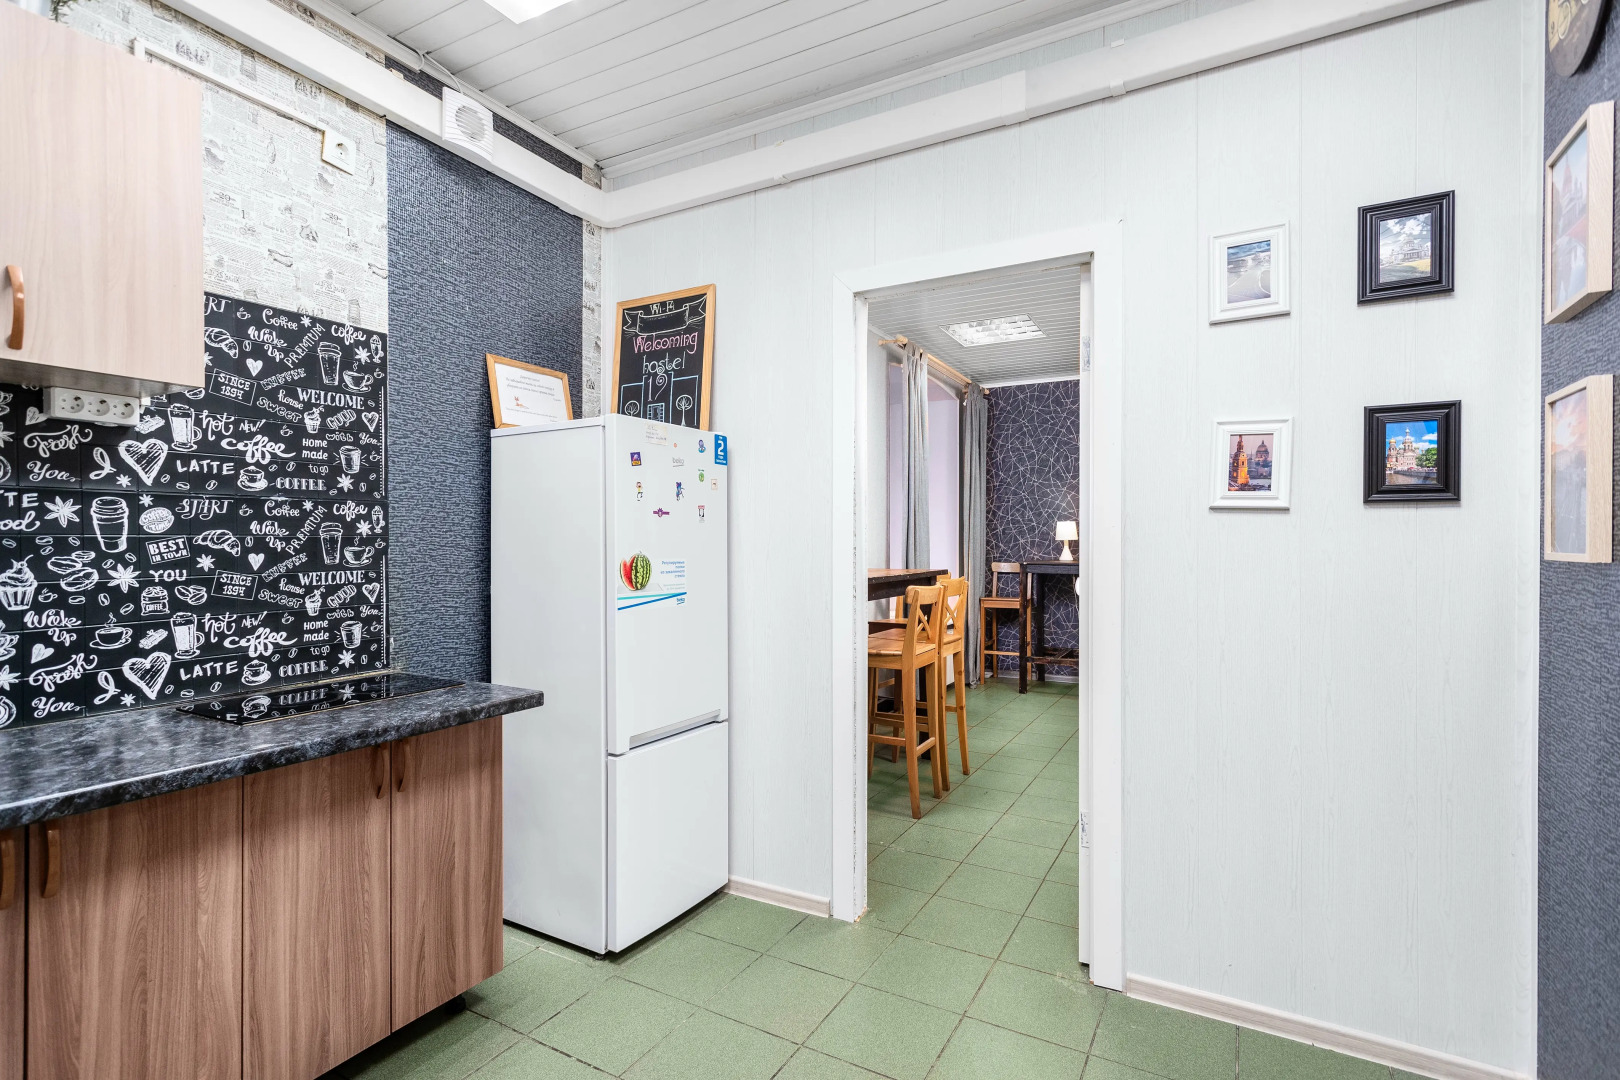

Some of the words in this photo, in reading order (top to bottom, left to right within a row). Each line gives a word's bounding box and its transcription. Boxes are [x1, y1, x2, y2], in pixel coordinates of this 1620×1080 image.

[262, 308, 298, 331] Coffee
[247, 326, 287, 348] Wake
[283, 323, 326, 368] PREMIUM
[633, 331, 698, 354] Welcoming
[643, 351, 686, 374] hostel
[217, 373, 250, 390] SINCE
[220, 385, 245, 400] 1894
[278, 389, 304, 410] house
[297, 387, 365, 410] WELCOME
[199, 409, 235, 441] hot
[239, 419, 266, 432] NEW!
[301, 449, 328, 460] made
[176, 459, 235, 475] LATTE
[275, 476, 327, 491] COFFEE
[175, 498, 233, 521] START
[264, 500, 300, 517] Coffee
[250, 520, 289, 537] Wake
[285, 505, 328, 555] PREMIUM
[149, 538, 185, 555] BEST
[152, 554, 163, 563] IN
[163, 549, 188, 561] TOWN
[149, 569, 187, 583] YOU
[219, 573, 252, 586] SINCE
[298, 570, 365, 586] WELCOME
[222, 585, 246, 596] 1894
[278, 577, 305, 595] house
[23, 609, 81, 628] Wake
[201, 612, 237, 643] hot
[47, 627, 77, 646] Up
[303, 631, 329, 642] made
[179, 661, 238, 681] LATTE
[278, 660, 328, 678] COFFEE
